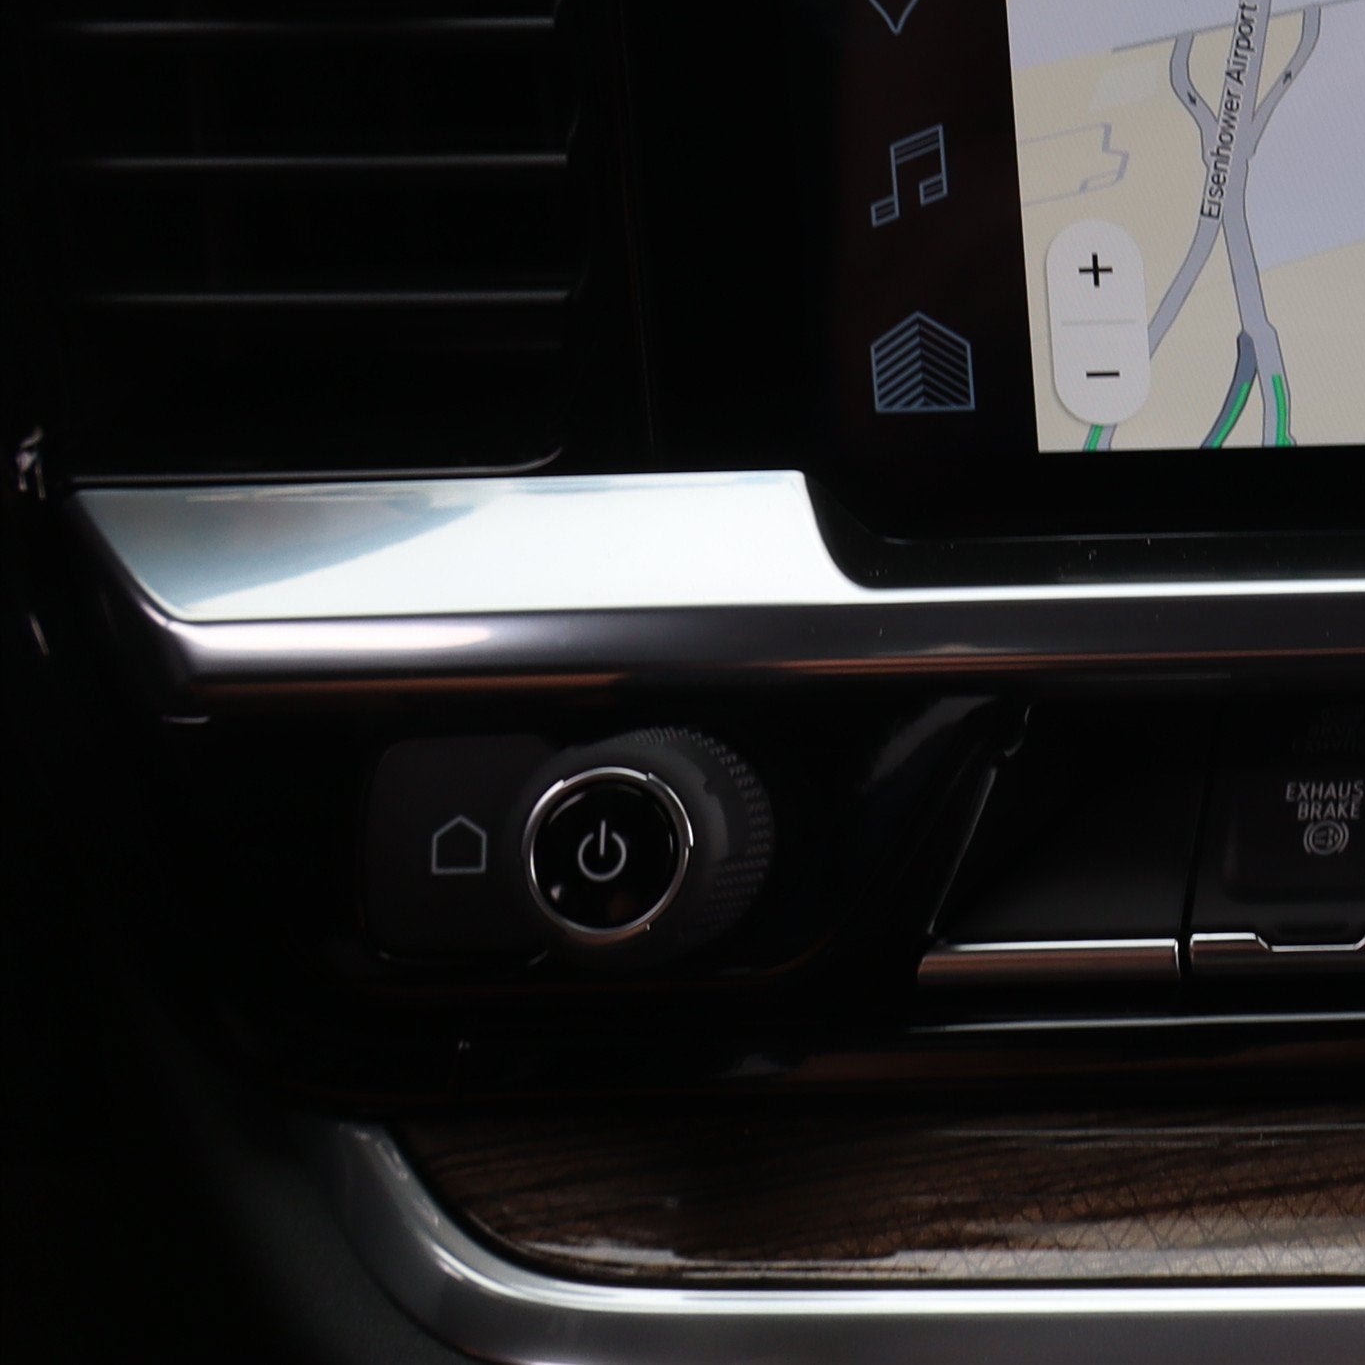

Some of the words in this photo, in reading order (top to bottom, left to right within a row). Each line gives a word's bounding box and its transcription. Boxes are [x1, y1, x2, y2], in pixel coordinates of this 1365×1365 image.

[1200, 87, 1243, 220] Eisenhower
[1225, 2, 1257, 86] Airport
[1297, 799, 1361, 821] BRAKE
